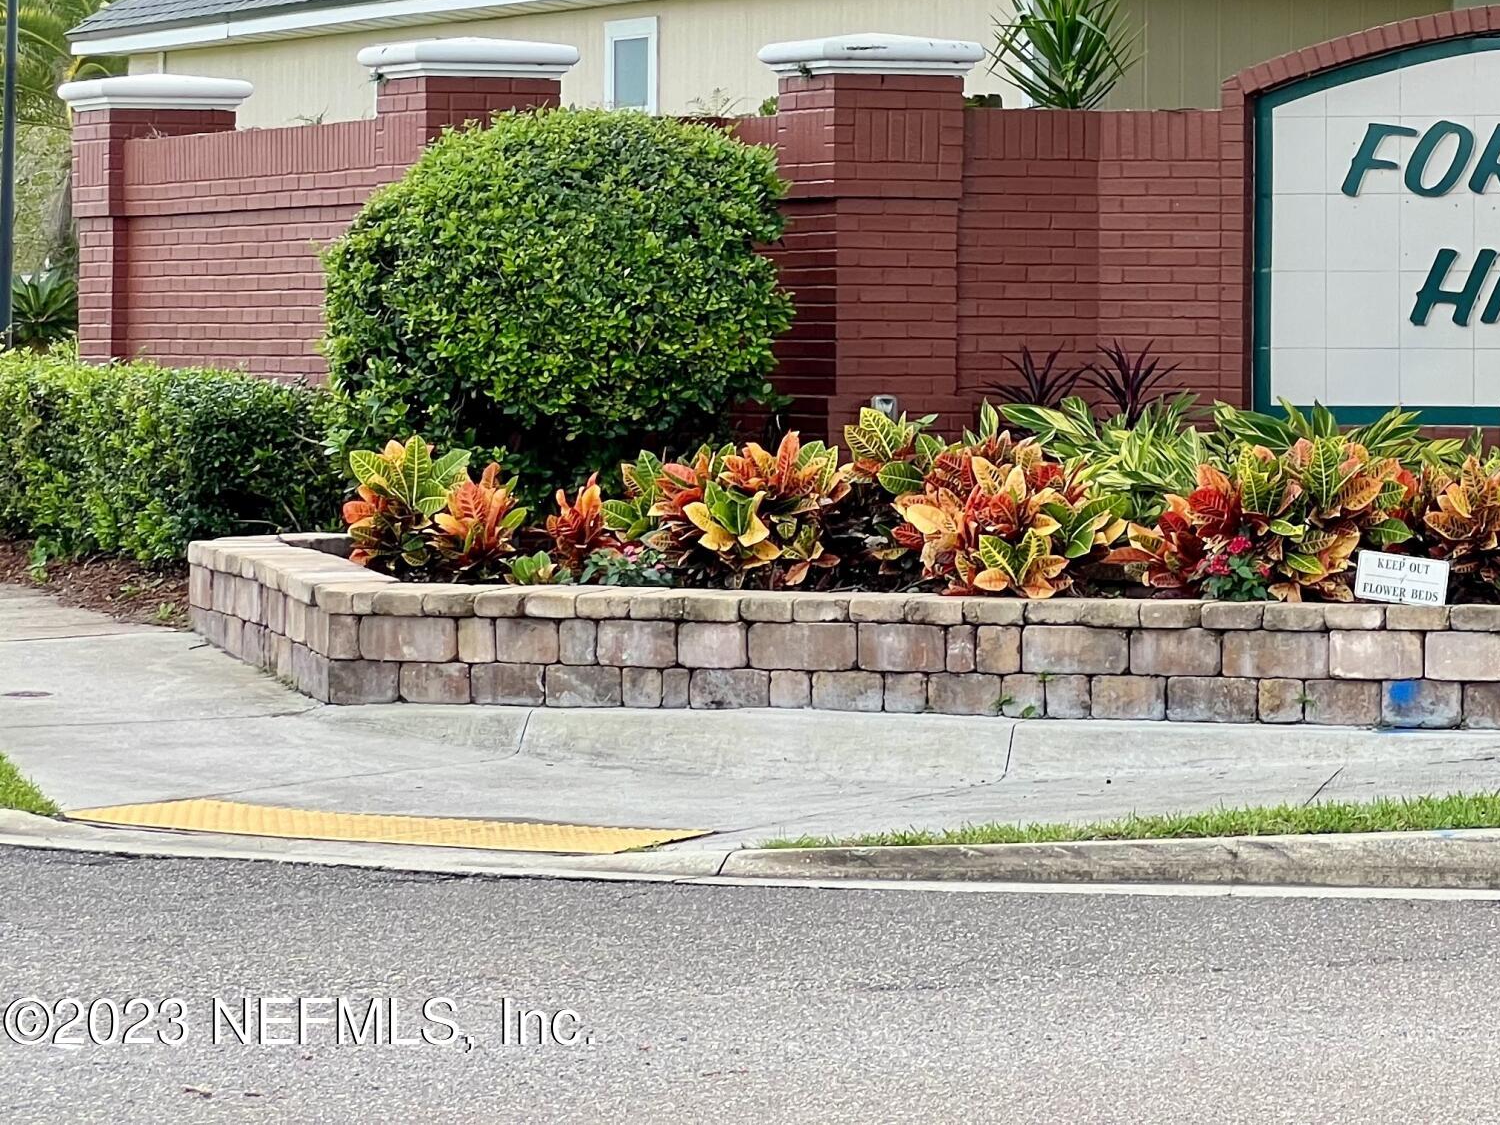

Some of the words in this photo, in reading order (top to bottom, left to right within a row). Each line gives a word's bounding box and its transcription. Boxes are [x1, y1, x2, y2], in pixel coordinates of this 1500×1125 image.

[1377, 558, 1406, 571] KEEP
[1409, 562, 1431, 575] OUT
[1362, 582, 1406, 597] FLOWER
[1411, 588, 1439, 602] BEDS
